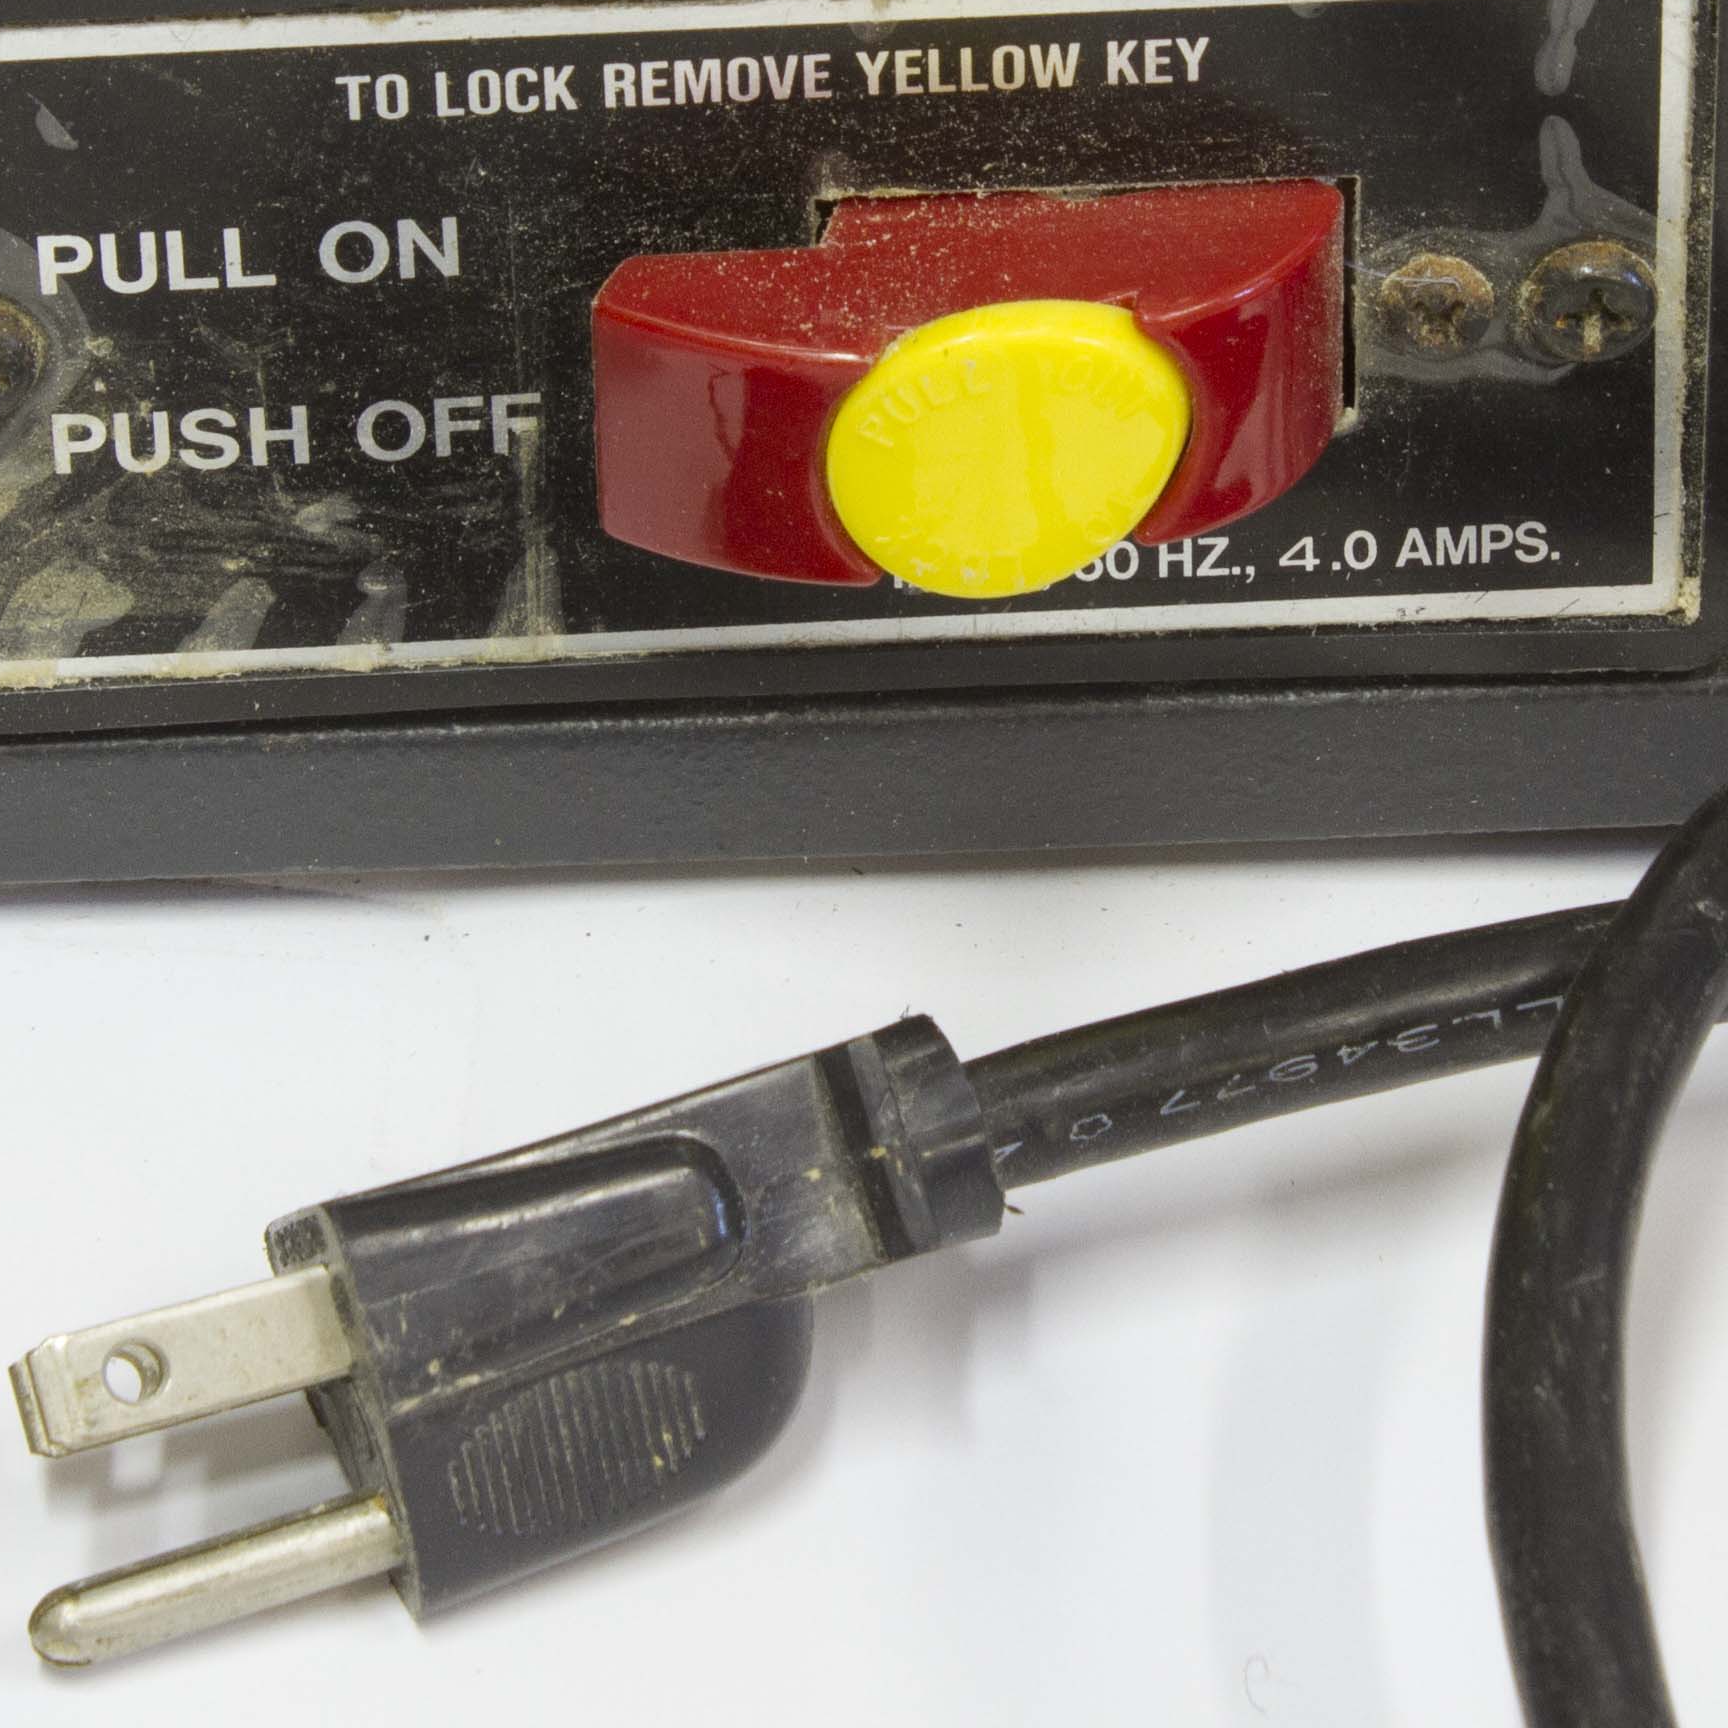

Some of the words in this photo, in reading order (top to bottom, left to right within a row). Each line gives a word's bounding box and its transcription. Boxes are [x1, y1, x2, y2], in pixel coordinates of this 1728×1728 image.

[335, 73, 409, 122] TO
[435, 64, 579, 118] LOCK
[604, 53, 833, 110] REMOVE
[855, 41, 1082, 97] YELLOW
[1104, 36, 1212, 87] KEY
[35, 227, 277, 296] PULL
[318, 216, 462, 284] ON
[50, 405, 311, 475] PUSH
[355, 392, 542, 462] OFF
[1278, 529, 1377, 572] 4.0
[1395, 521, 1561, 567] AMPS.
